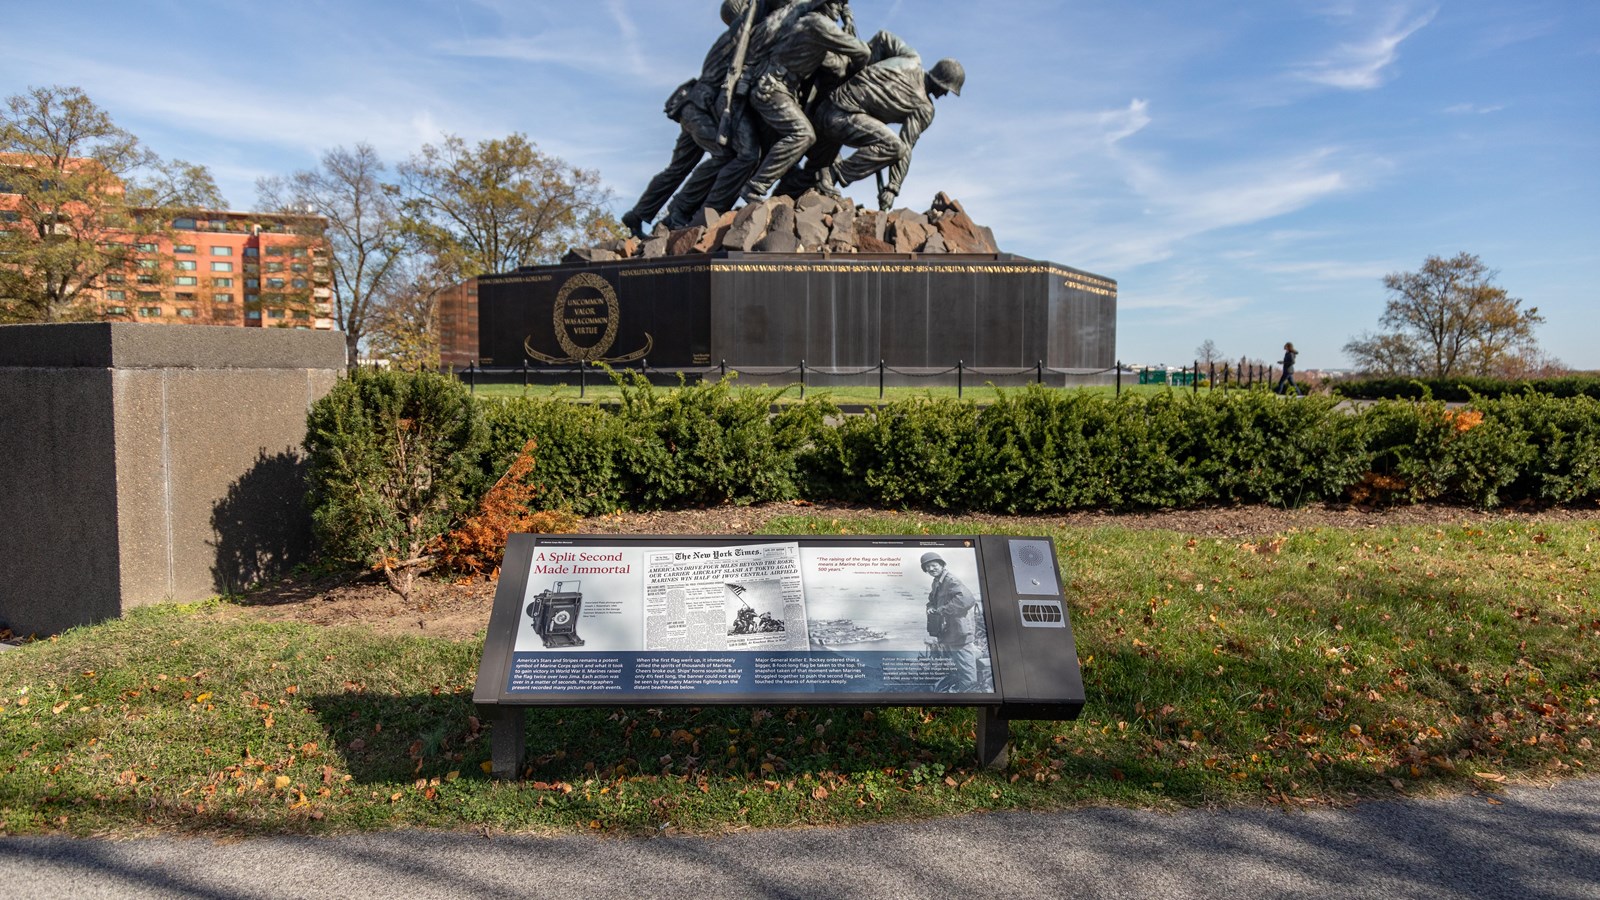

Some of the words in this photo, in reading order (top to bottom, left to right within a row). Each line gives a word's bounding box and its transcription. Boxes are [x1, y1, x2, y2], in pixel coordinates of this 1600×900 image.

[536, 553, 545, 561] A
[549, 552, 576, 564] Split
[579, 552, 622, 561] Second
[712, 551, 733, 559] York
[534, 565, 569, 574] Made
[572, 565, 631, 574] Immortal
